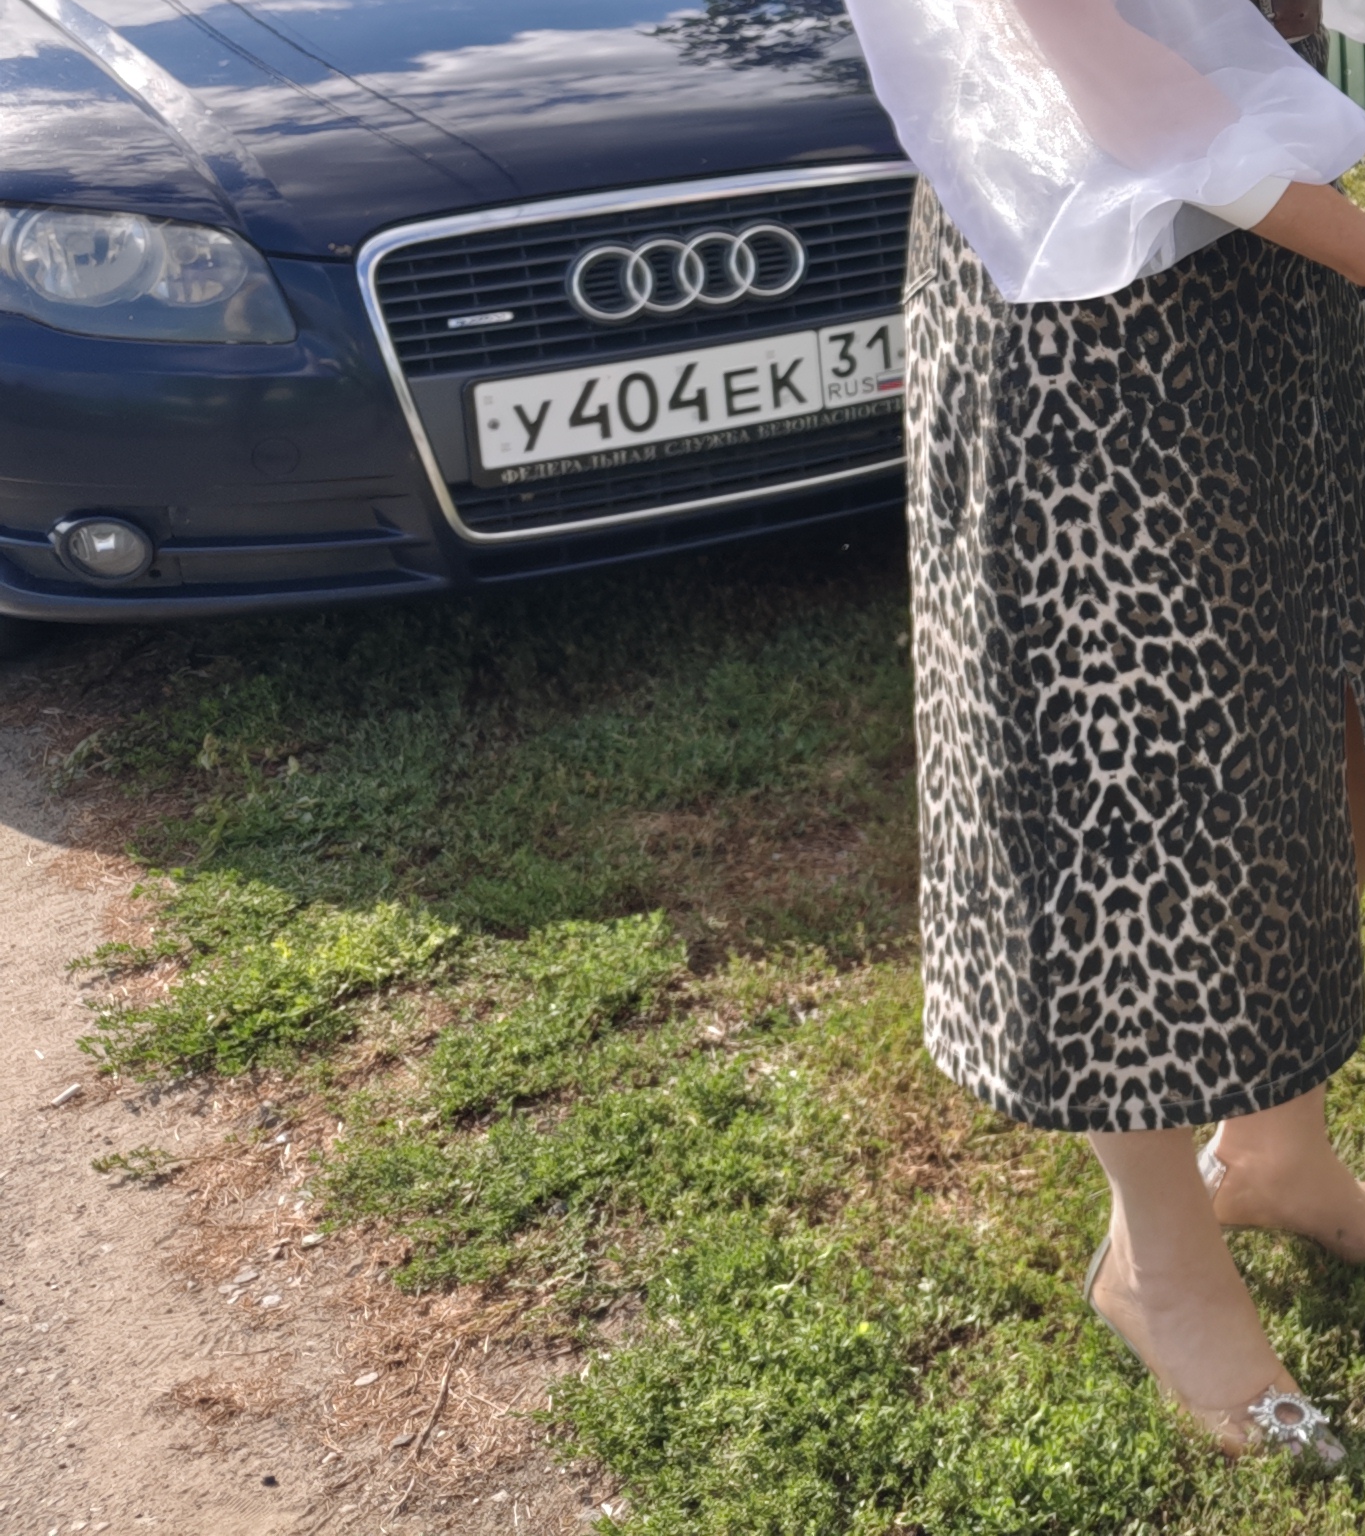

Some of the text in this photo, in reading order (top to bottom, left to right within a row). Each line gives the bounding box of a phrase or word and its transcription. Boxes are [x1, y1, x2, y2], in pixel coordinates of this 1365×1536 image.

[513, 324, 892, 453] У404ЕК 31
[828, 376, 875, 400] RUS
[501, 444, 657, 485] ФЕДЕРАЛЬНАЯ
[664, 428, 750, 456] СЛУЖБА
